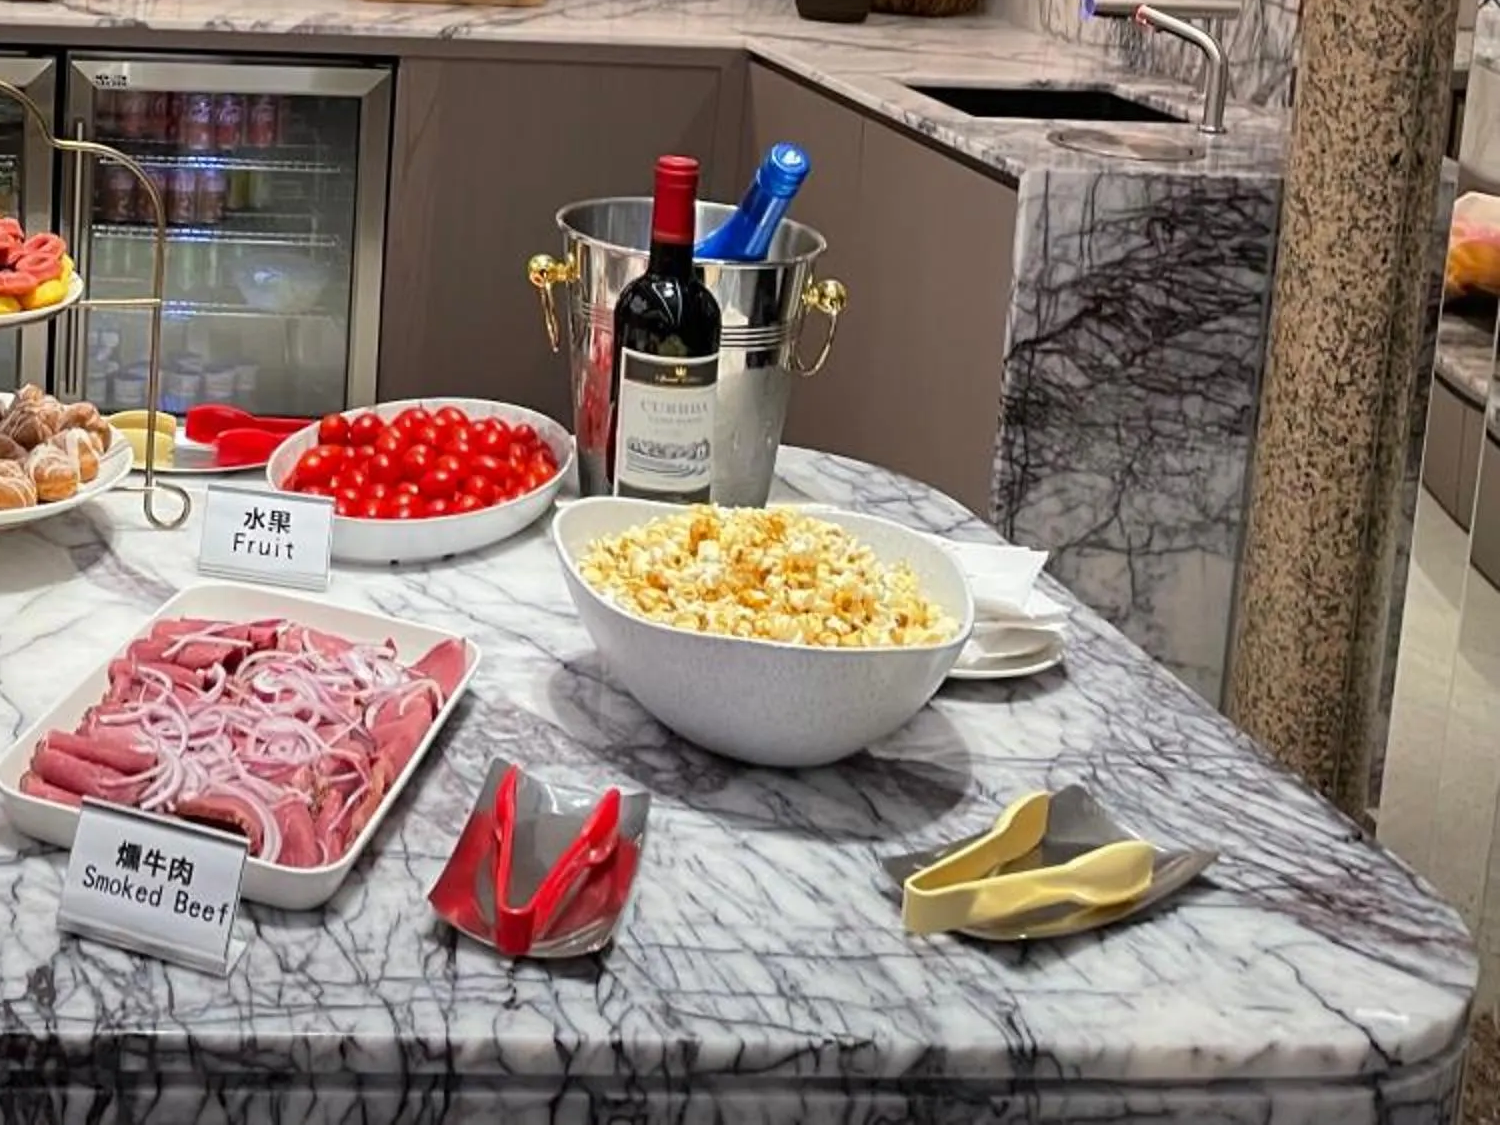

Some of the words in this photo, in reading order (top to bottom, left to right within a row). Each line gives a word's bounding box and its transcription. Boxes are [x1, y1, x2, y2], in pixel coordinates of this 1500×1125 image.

[243, 506, 291, 534] 水果
[233, 532, 295, 560] Fruit
[82, 863, 164, 908] Smoked
[173, 890, 230, 926] Beef
